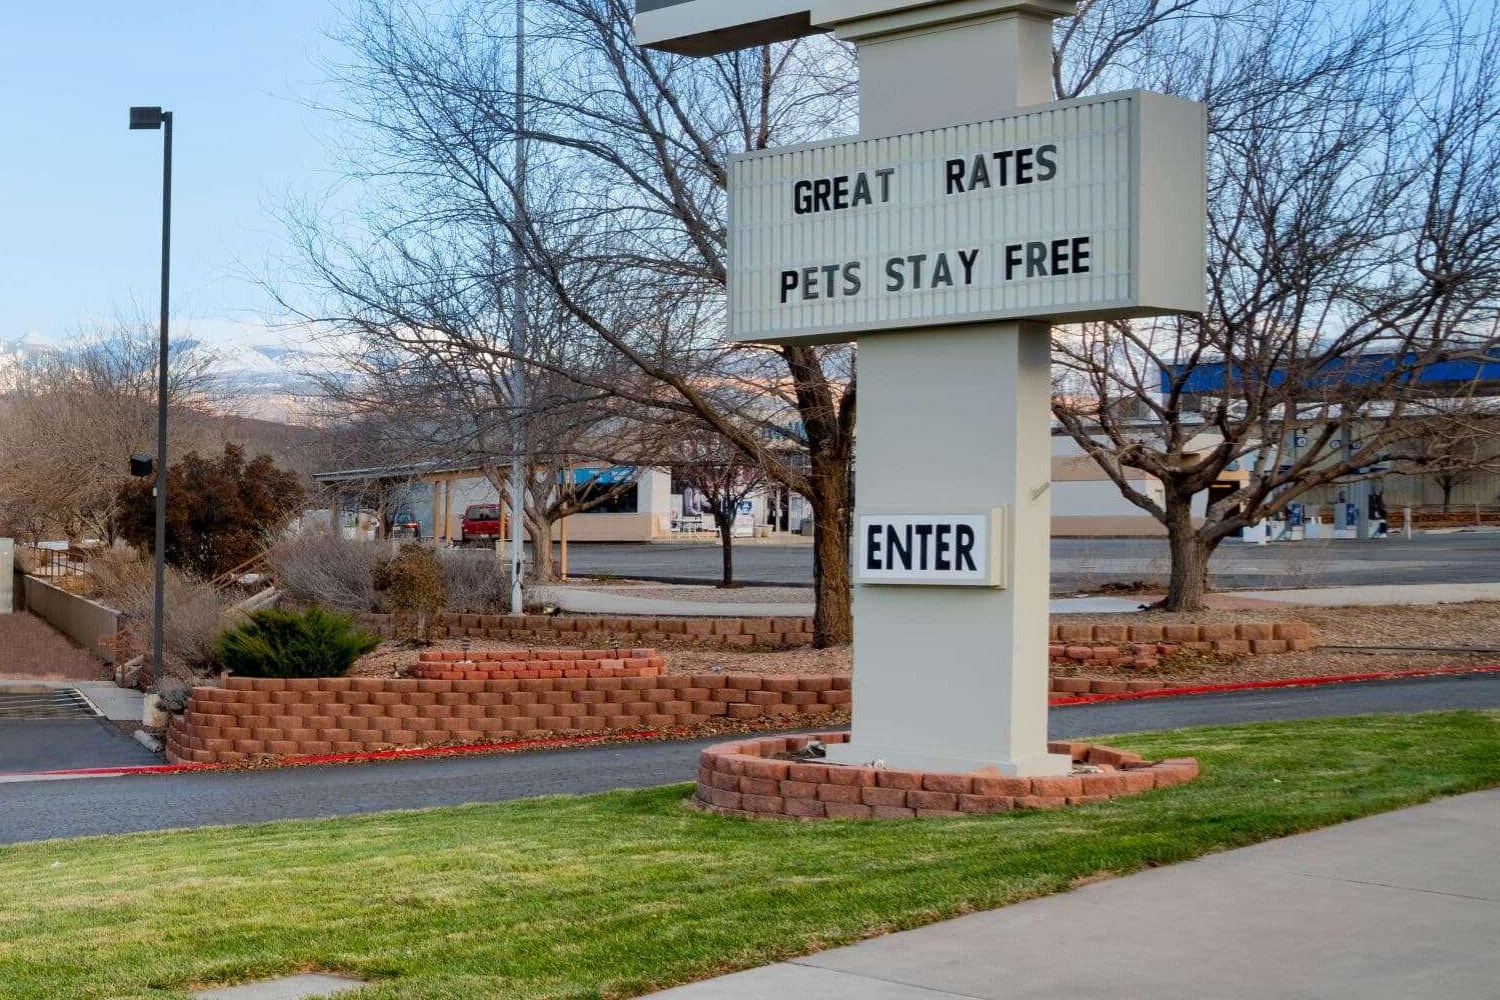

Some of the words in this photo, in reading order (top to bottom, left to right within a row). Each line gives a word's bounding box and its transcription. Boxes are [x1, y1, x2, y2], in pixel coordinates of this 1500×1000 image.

[793, 168, 894, 214] GREAT
[946, 145, 1057, 194] RATES
[780, 261, 861, 303] PETS
[885, 249, 979, 292] STAY
[1004, 236, 1090, 281] FREE
[866, 523, 977, 571] ENTER
